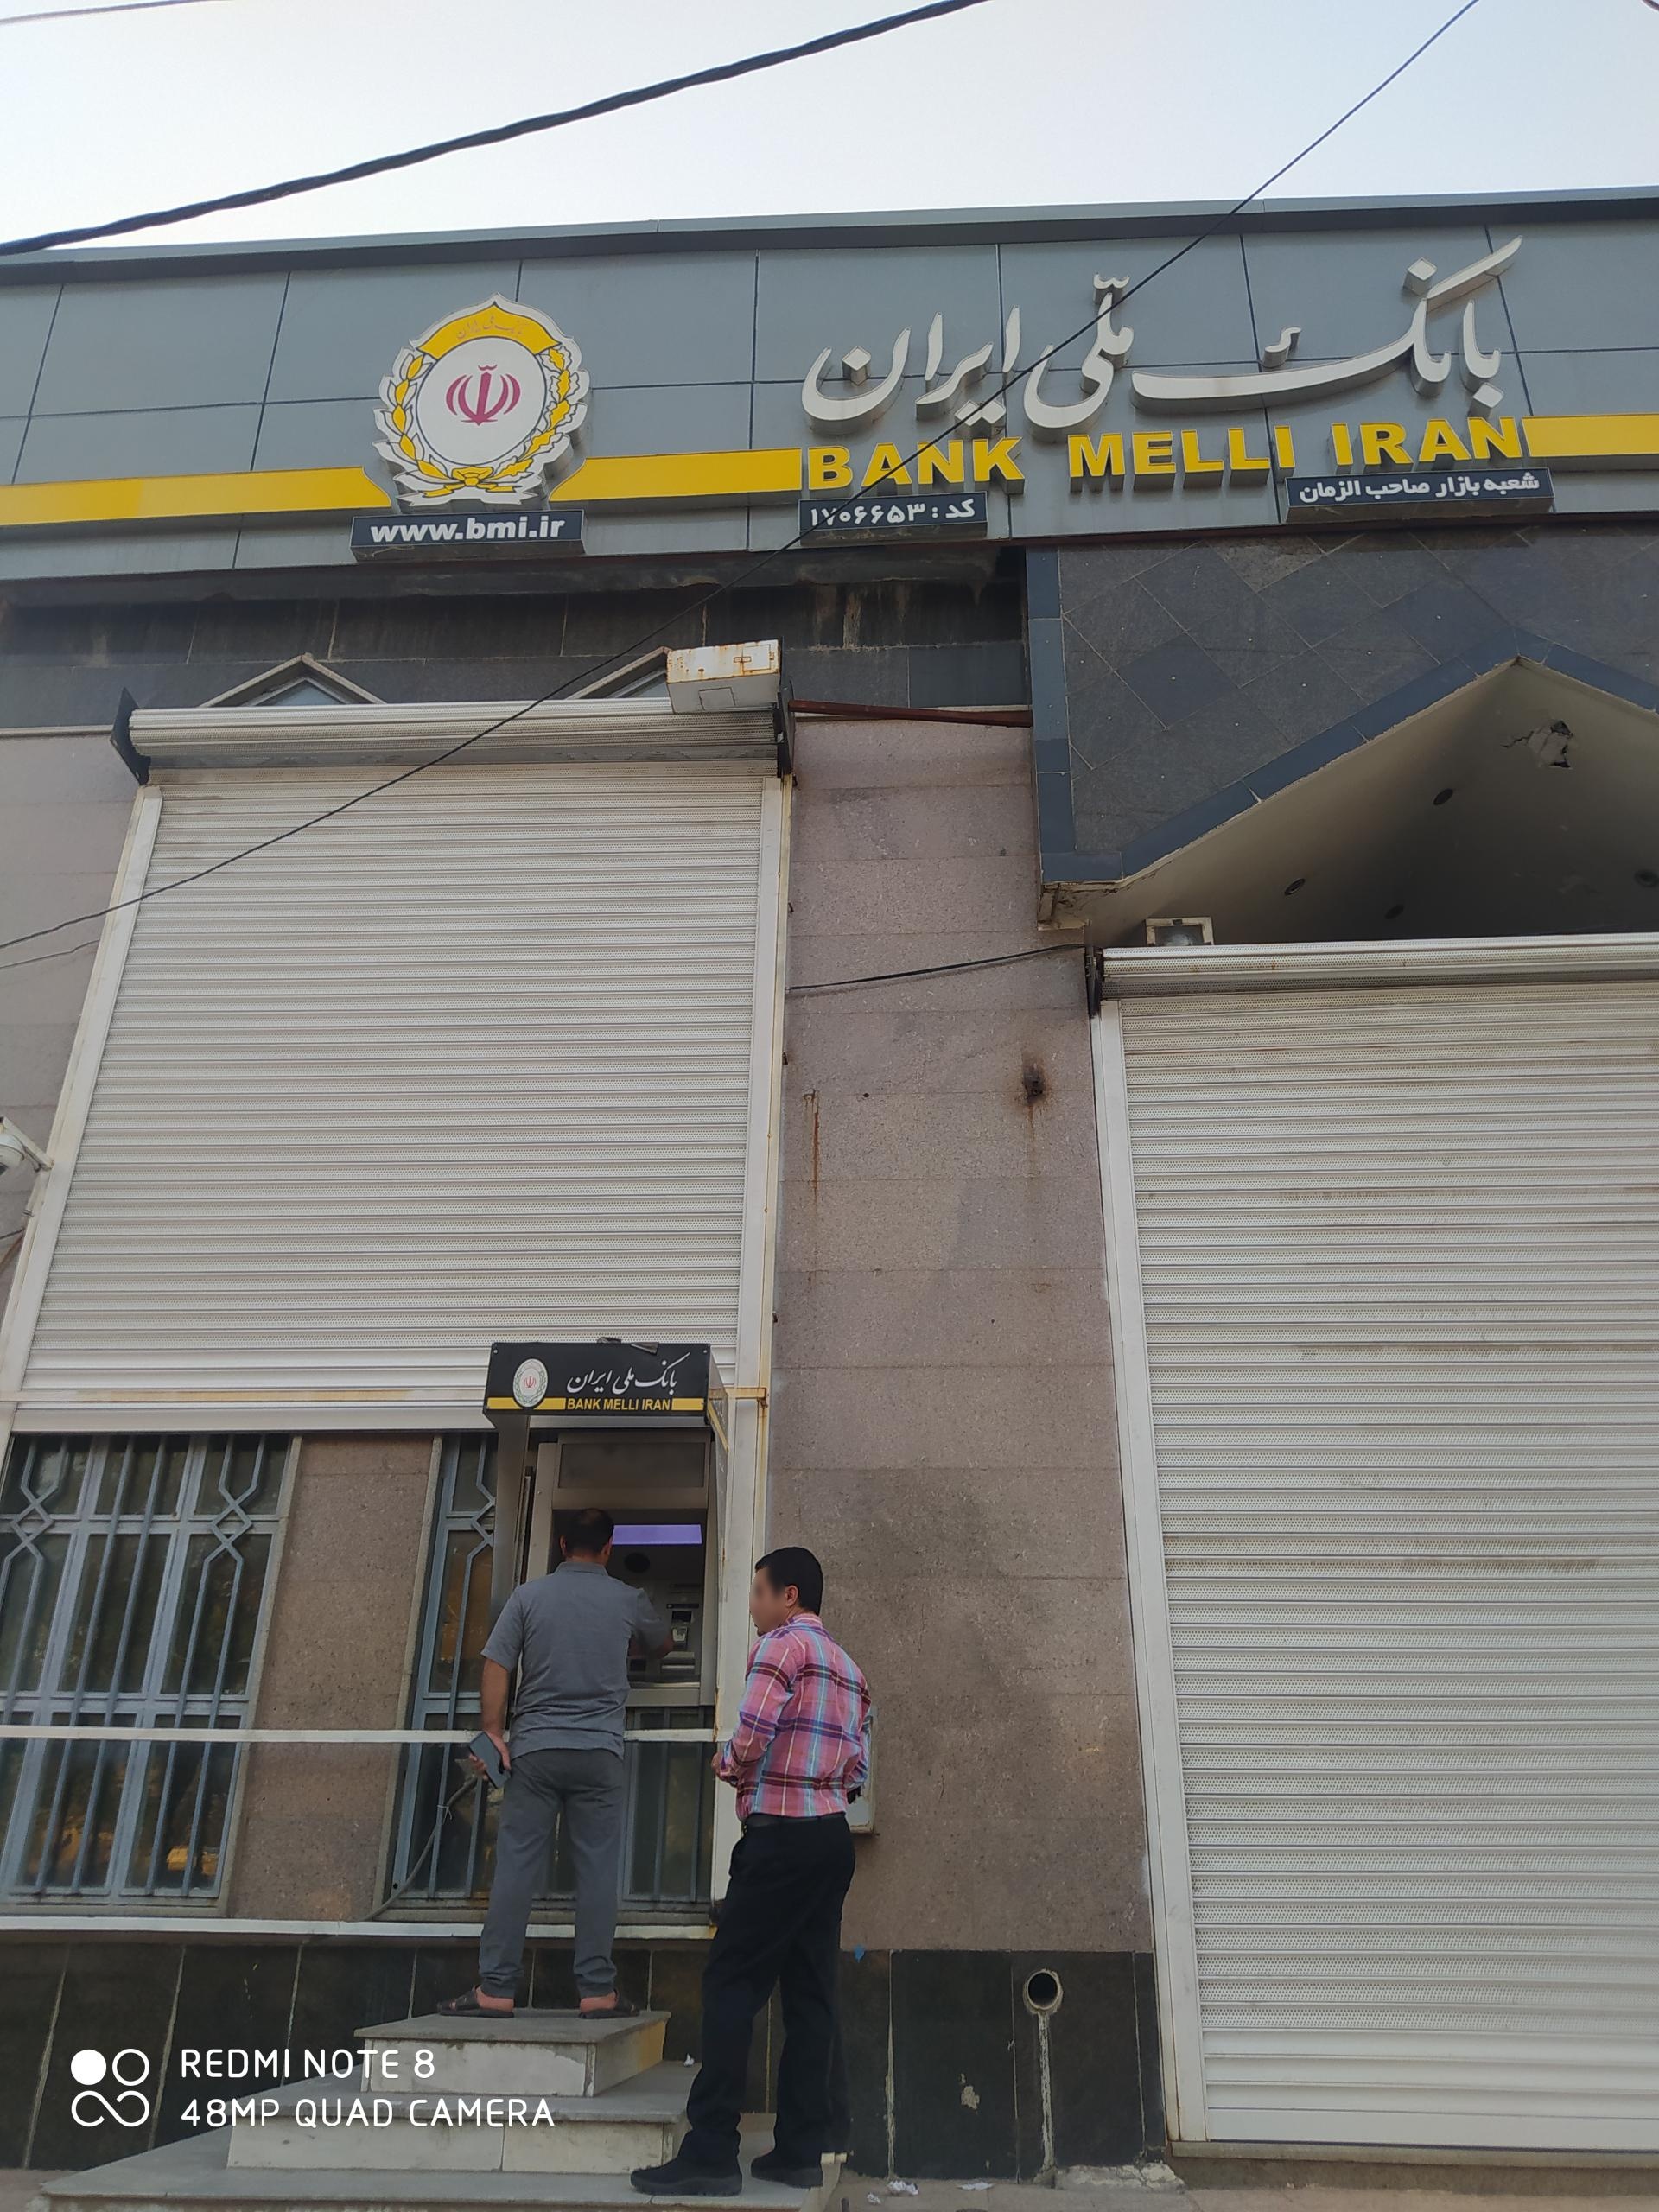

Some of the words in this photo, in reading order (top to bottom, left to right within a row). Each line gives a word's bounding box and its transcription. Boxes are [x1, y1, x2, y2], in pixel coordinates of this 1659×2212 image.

[1131, 234, 1524, 410] بانک
[801, 305, 1021, 428] ایران
[809, 437, 1023, 489] BANK
[1069, 426, 1294, 478] MELLI
[1332, 416, 1522, 466] IRAN
[1299, 479, 1362, 504] الزمان
[1364, 478, 1431, 500] صاحب
[1434, 476, 1481, 499] بازار
[1483, 472, 1541, 496] شعبه
[370, 515, 566, 543] www.bmi.ir
[566, 1369, 613, 1394] ایران
[611, 1366, 635, 1395] ملی
[634, 1351, 690, 1395] بانک
[567, 1397, 601, 1411] BANK
[603, 1398, 639, 1411] MELLI
[641, 1398, 671, 1411] IRAN
